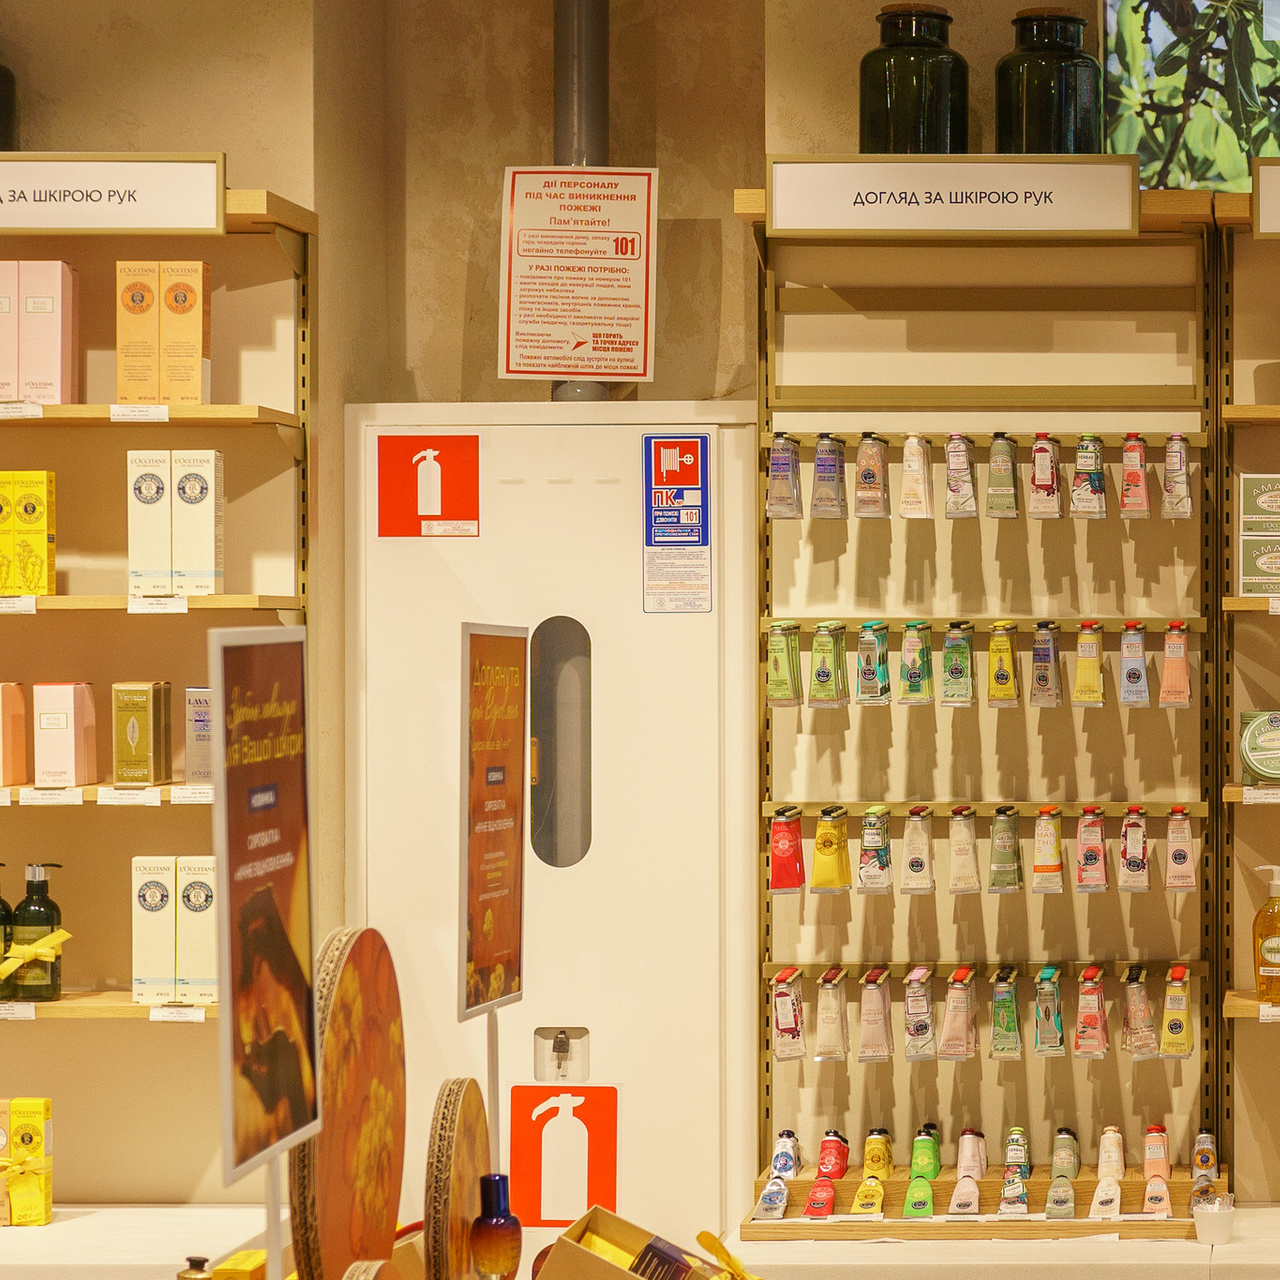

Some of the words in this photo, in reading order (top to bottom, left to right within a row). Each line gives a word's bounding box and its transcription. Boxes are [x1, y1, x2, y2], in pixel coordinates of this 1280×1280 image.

[8, 190, 27, 202] ЗА
[33, 189, 102, 202] ШКІРОЮ
[108, 189, 137, 204] РУК
[526, 192, 542, 200] ПІД
[853, 192, 920, 207] ДОГЛЯД
[925, 192, 944, 204] ЗА
[949, 191, 1019, 204] ШКІРОЮ
[1024, 192, 1054, 206] РУК
[560, 204, 601, 212] ПОЖЕЖІ
[550, 217, 610, 226] Пам'ятайте!
[613, 237, 635, 255] 101
[556, 248, 607, 256] телефонуйте
[653, 490, 676, 506] ПК
[686, 511, 697, 522] 101
[473, 659, 519, 695] Доглянута
[119, 693, 147, 701] Verveine
